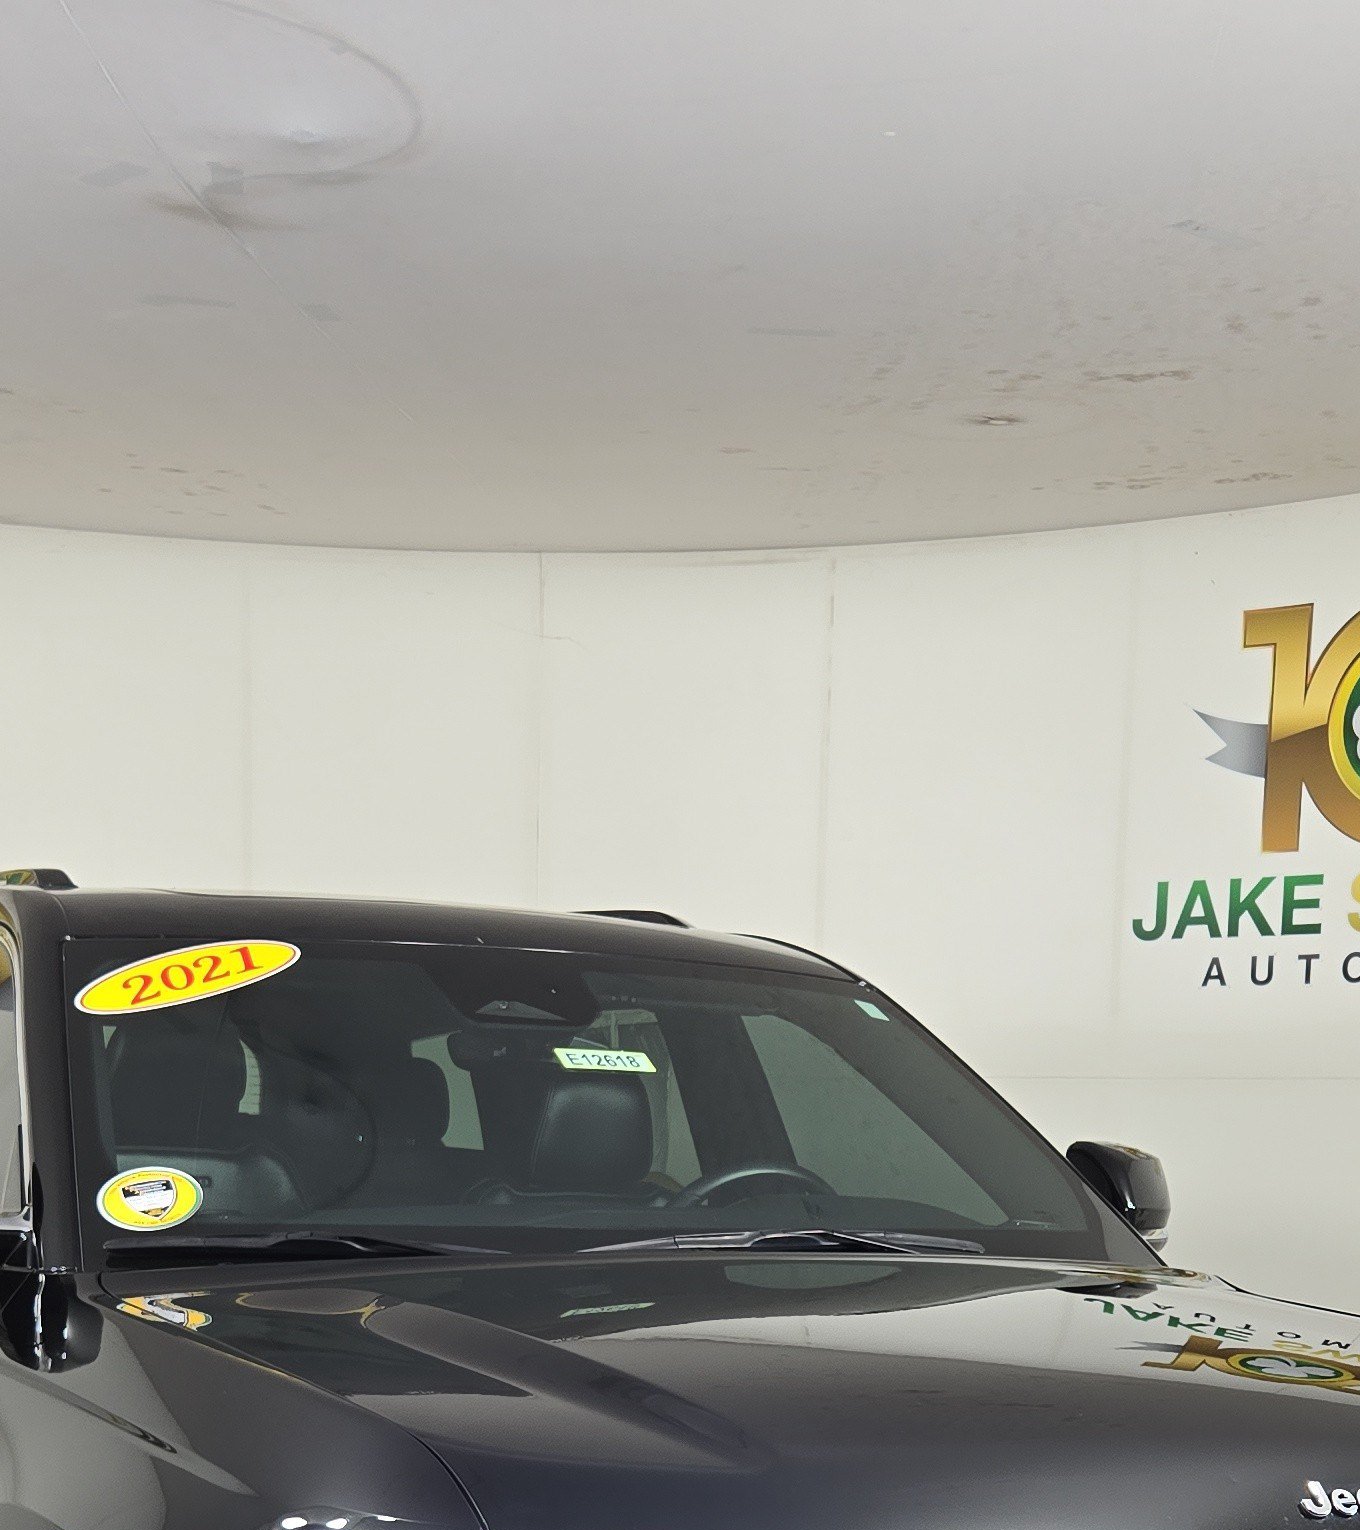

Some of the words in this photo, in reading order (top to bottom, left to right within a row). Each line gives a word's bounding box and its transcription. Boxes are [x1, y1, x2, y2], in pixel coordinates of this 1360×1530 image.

[1132, 873, 1324, 941] JAKE
[122, 946, 264, 1006] 2021
[565, 1052, 642, 1069] E12618
